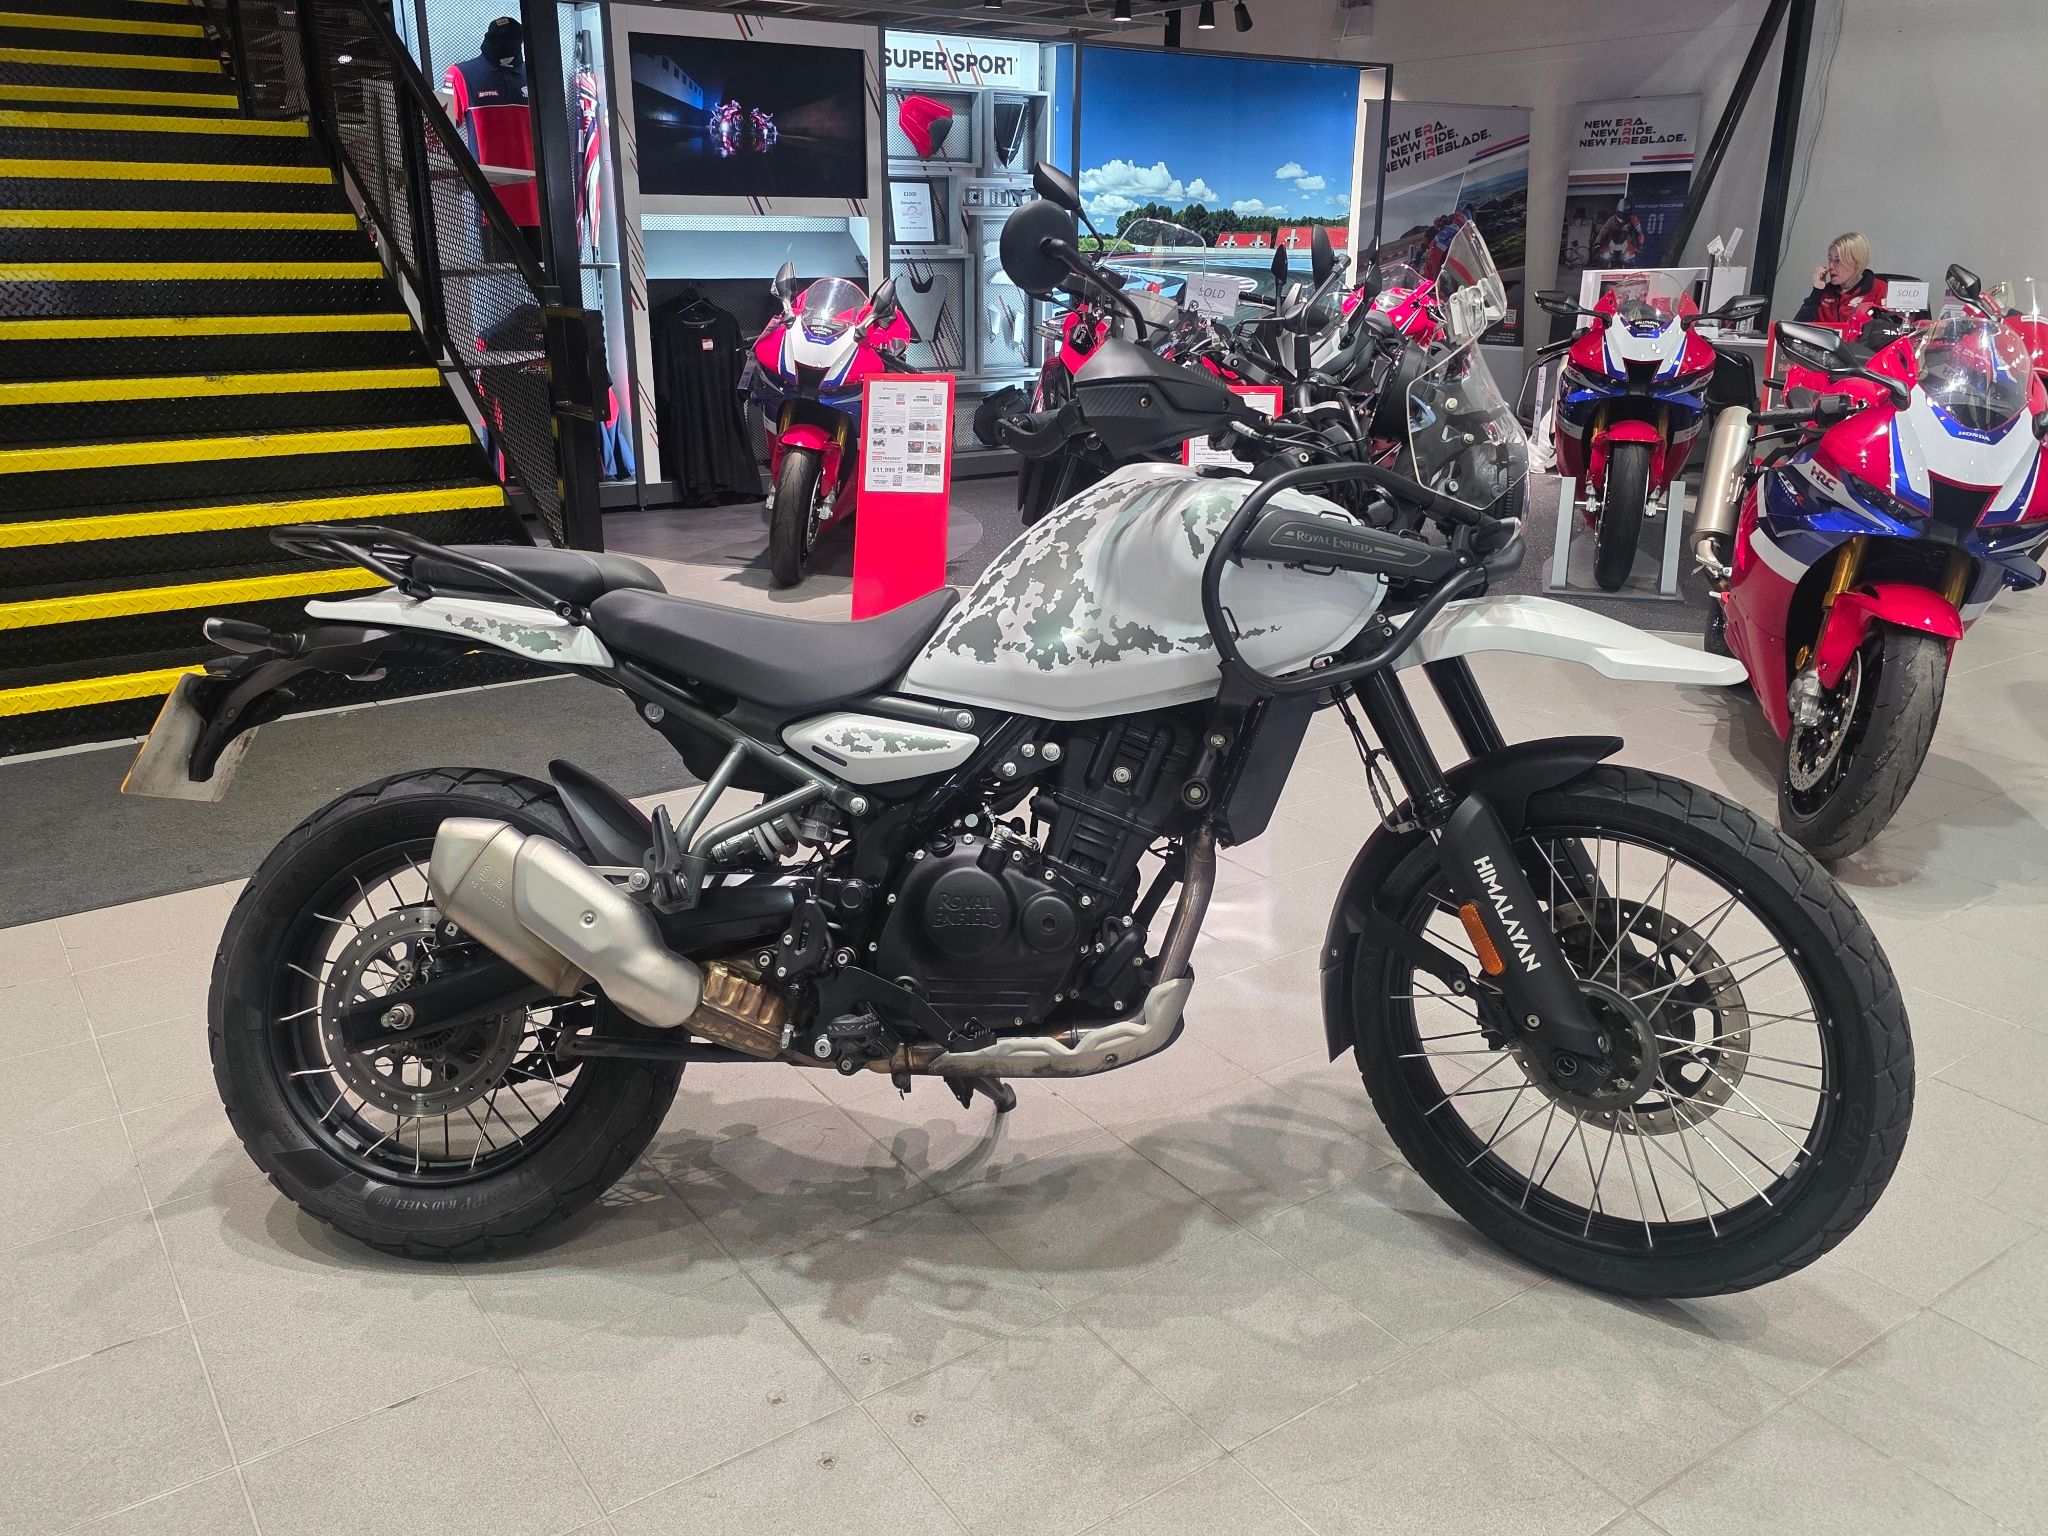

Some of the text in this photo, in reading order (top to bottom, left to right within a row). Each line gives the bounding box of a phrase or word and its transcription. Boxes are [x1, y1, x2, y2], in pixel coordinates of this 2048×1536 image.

[885, 48, 948, 71] SUPER
[478, 90, 499, 98] MOTUL
[1415, 121, 1448, 138] ERA.
[1584, 117, 1648, 129] NEW ERA.
[1590, 126, 1656, 138] NEW RIDE.
[1391, 128, 1459, 159] NEW RIDE.
[1415, 129, 1492, 163] FIREBLADE.
[1579, 133, 1688, 148] NEW FIREBLADE.
[1646, 213, 1665, 234] 01
[1198, 287, 1226, 299] SOLD
[1896, 289, 1920, 298] SOLD
[1957, 430, 1991, 442] HONDA
[1810, 465, 1838, 491] HRC
[938, 893, 996, 910] ROYAL
[1473, 855, 1542, 973] HIMALAYAN
[394, 1198, 430, 1212] STEEL
[431, 1199, 457, 1212] RAD
